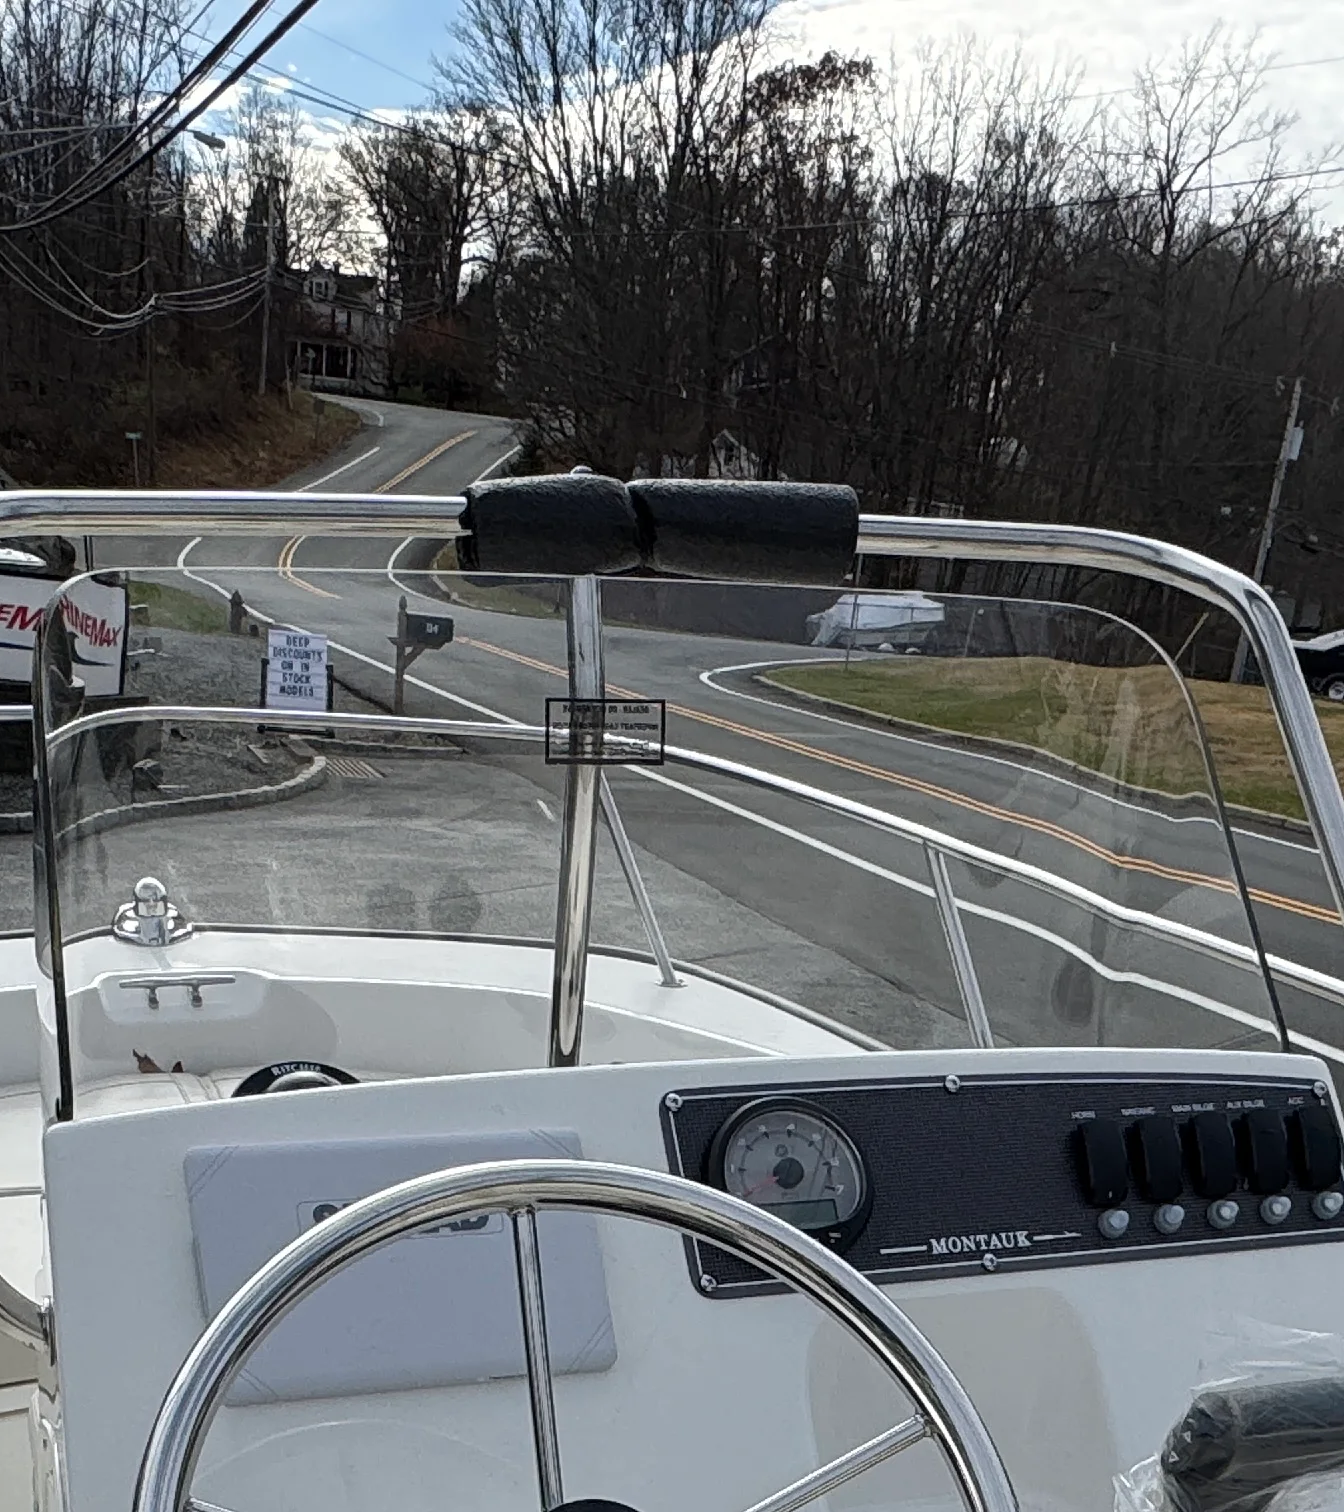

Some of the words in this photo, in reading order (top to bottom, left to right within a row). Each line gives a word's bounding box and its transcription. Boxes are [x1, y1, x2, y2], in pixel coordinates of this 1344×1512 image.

[59, 593, 123, 648] RINEMAX
[286, 634, 310, 646] DEEP
[272, 647, 323, 662] DISCOUNTS
[281, 660, 294, 671] ON
[301, 661, 310, 671] IN
[282, 672, 311, 683] STOCK
[279, 685, 314, 697] MODELS
[929, 1230, 1033, 1255] MONTAUK
